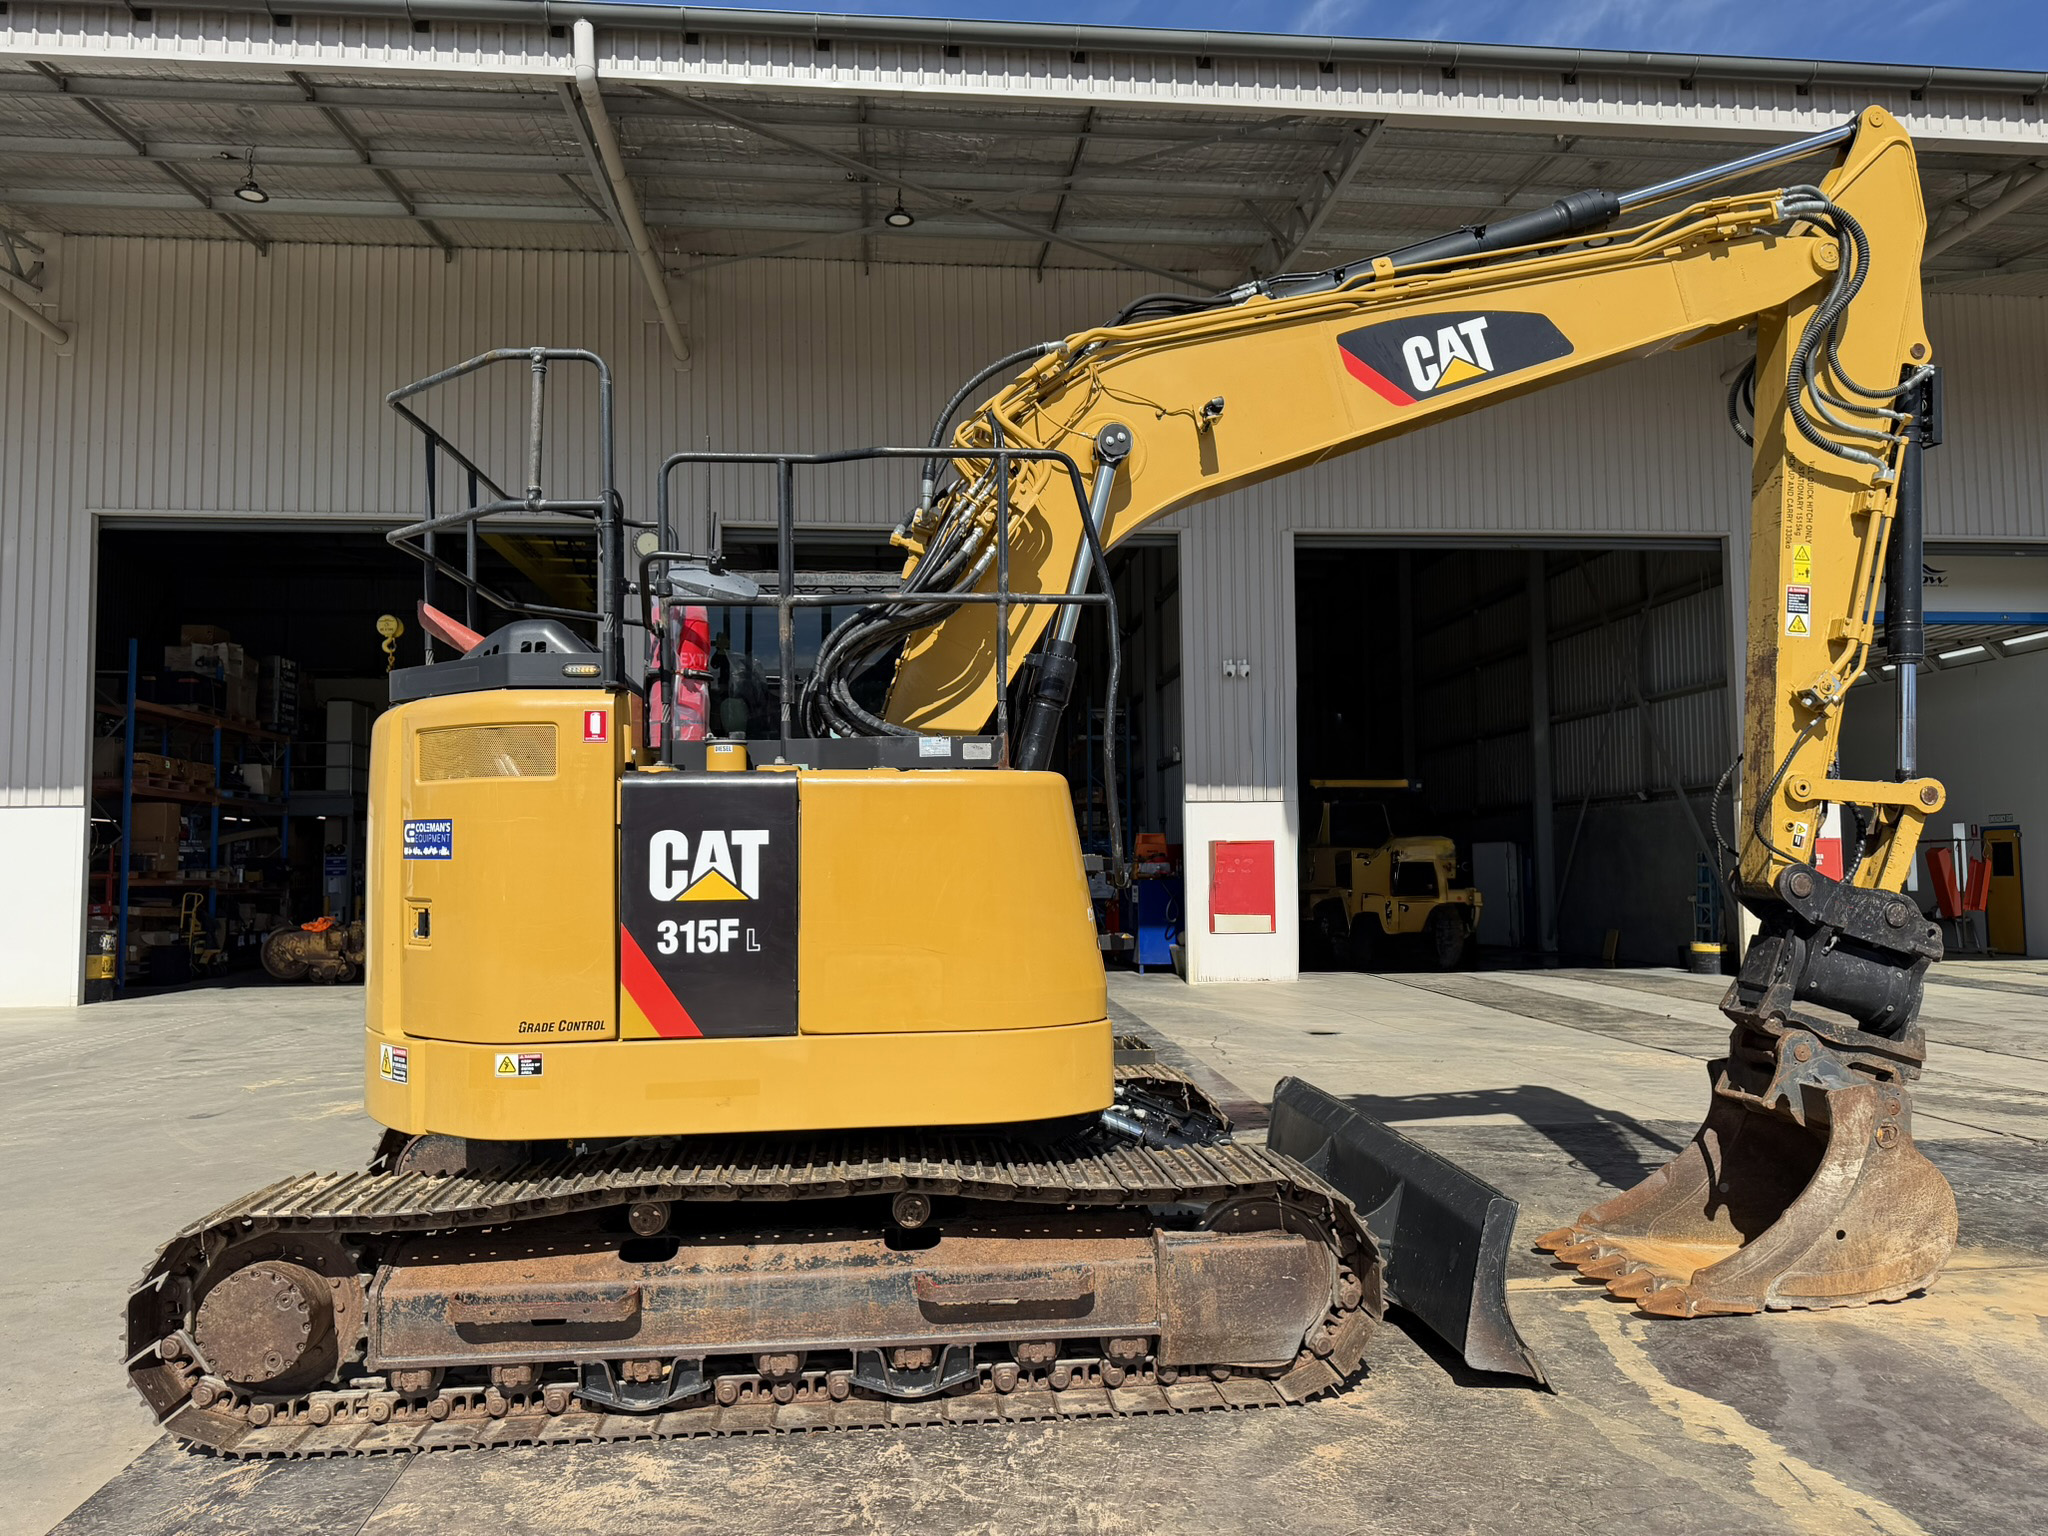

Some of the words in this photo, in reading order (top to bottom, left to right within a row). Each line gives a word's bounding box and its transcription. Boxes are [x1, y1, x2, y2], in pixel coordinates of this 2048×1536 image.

[1402, 315, 1494, 392] CAT
[1786, 481, 1795, 497] AND
[1796, 466, 1806, 511] STATIONARY
[1807, 475, 1815, 500] QUICK
[1786, 498, 1794, 524] CARRY
[1806, 501, 1814, 524] HITCH
[1805, 525, 1814, 544] ONLY
[415, 822, 451, 833] COLEMAN'S
[415, 833, 451, 843] EQUIPMENT
[649, 829, 770, 901] CAT
[657, 918, 740, 955] 315F
[746, 928, 761, 952] L
